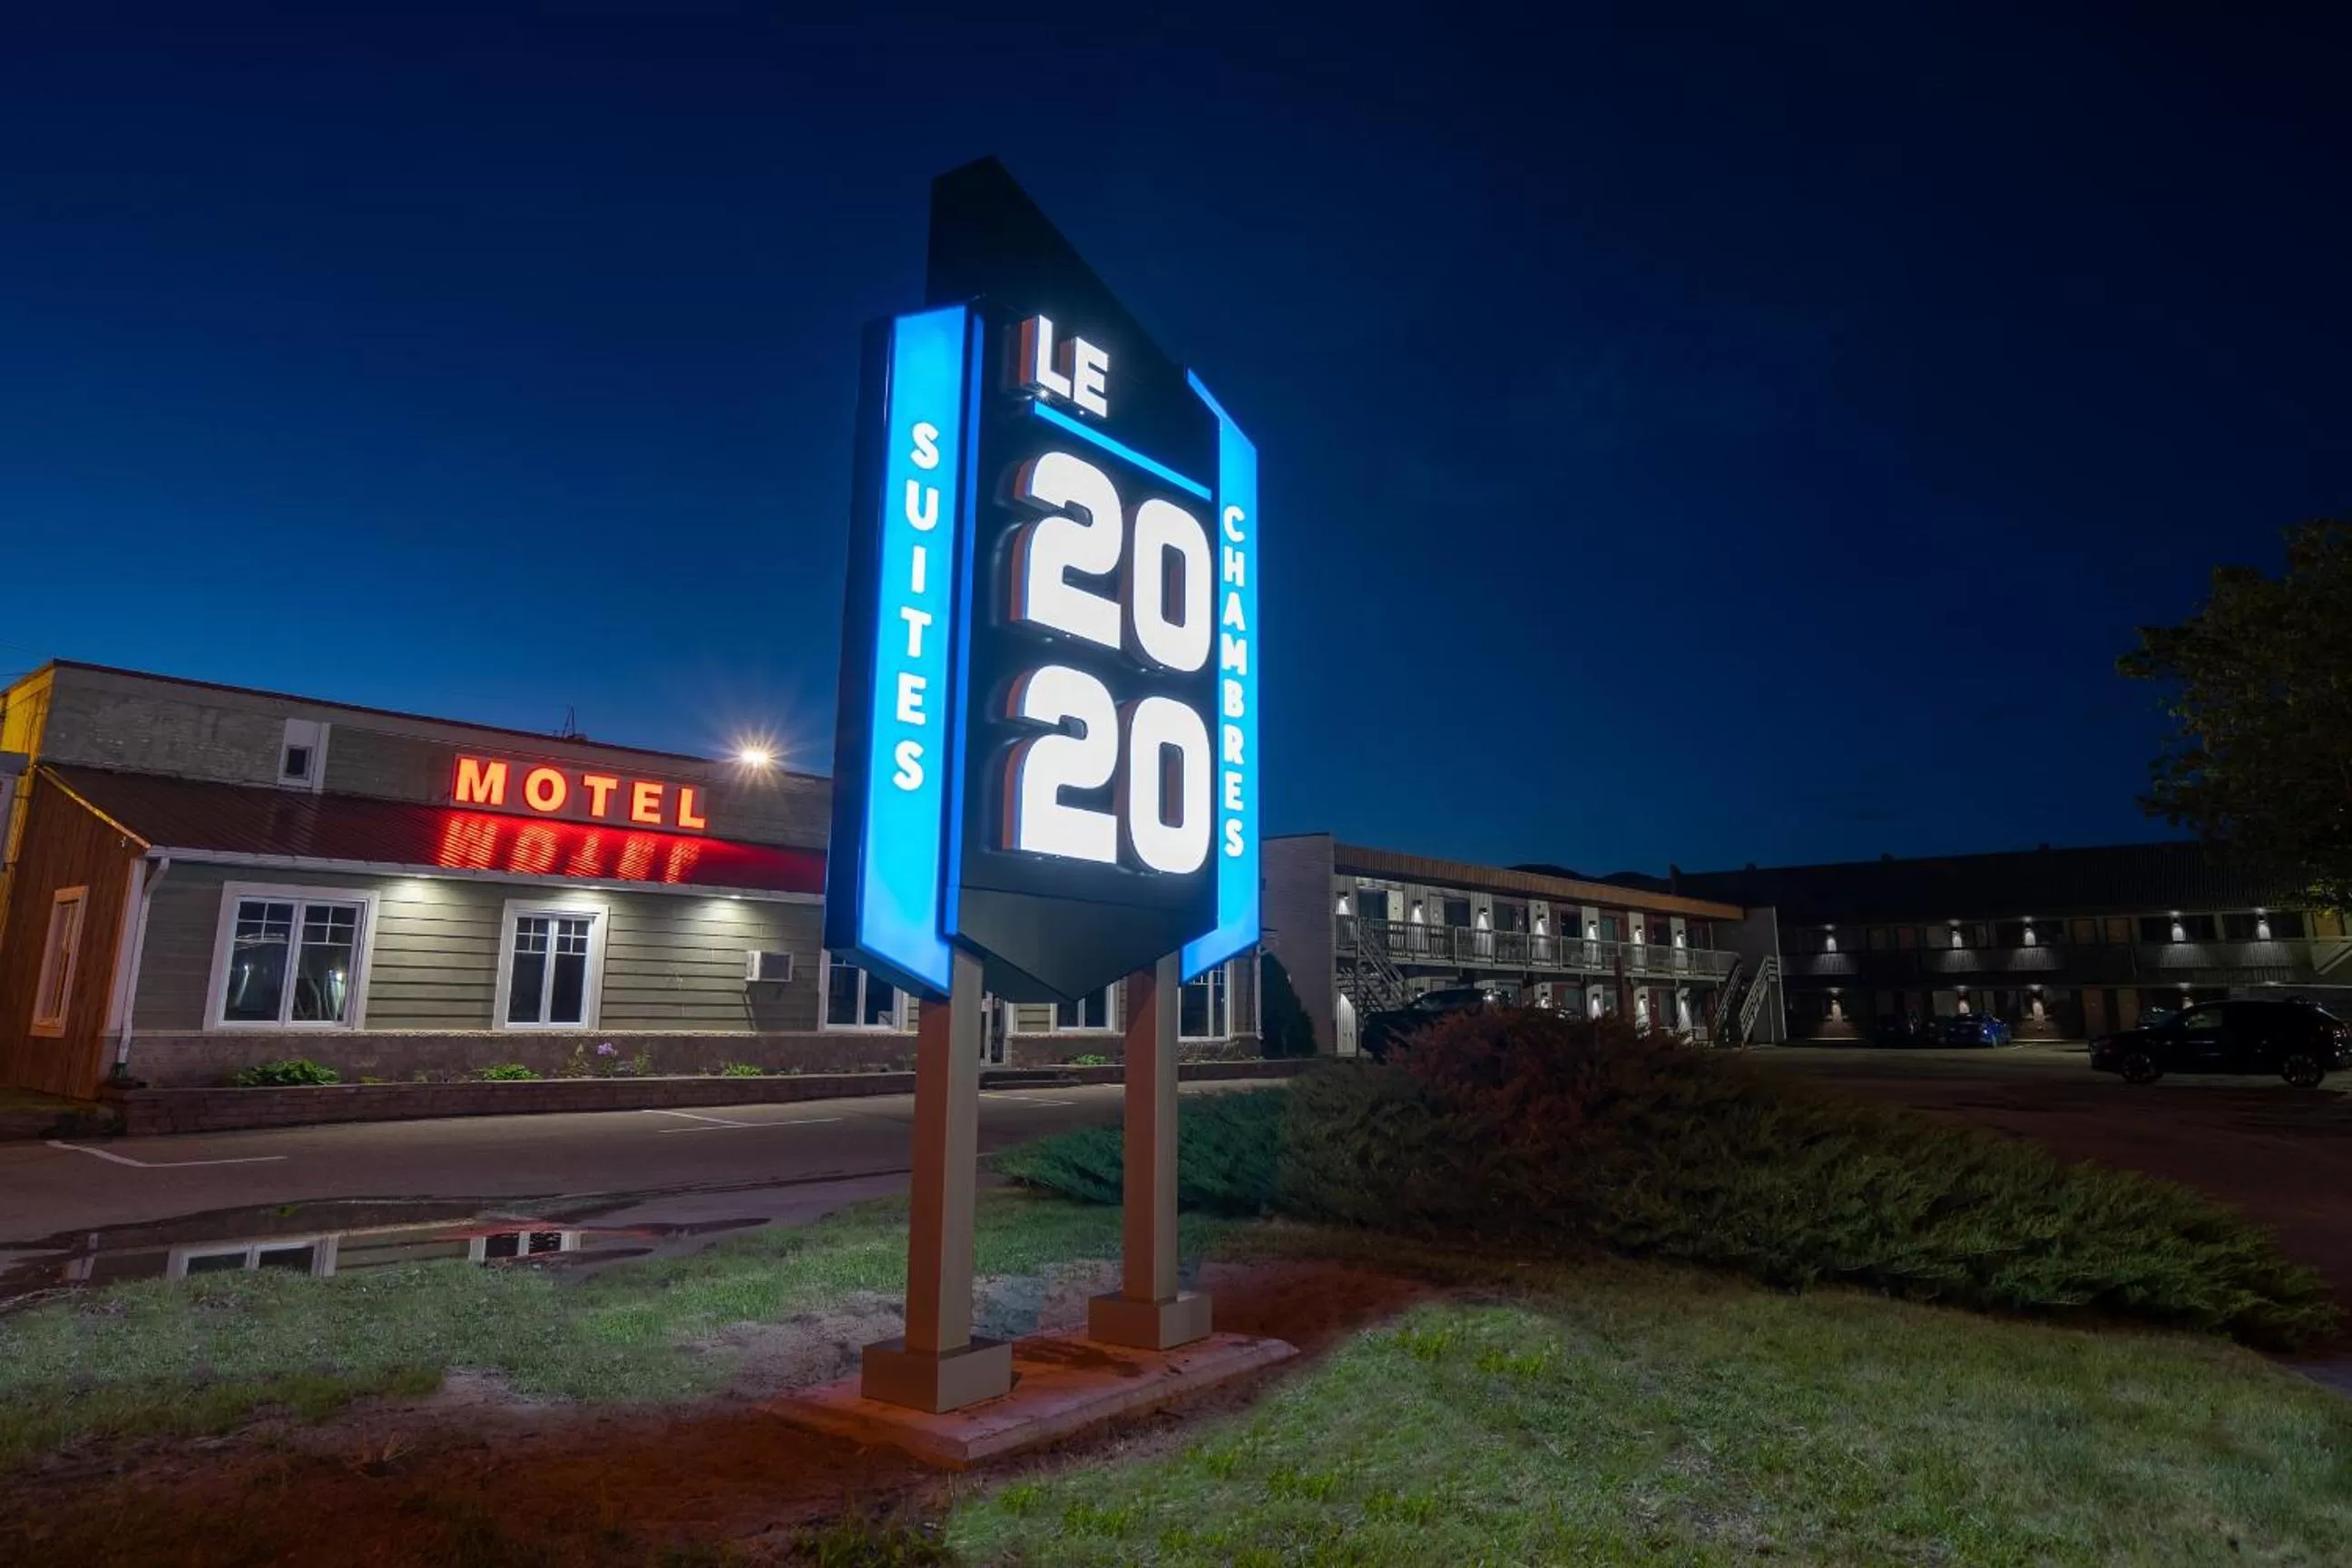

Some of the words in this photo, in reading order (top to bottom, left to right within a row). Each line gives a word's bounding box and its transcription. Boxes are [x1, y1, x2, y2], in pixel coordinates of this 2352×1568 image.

[1034, 314, 1109, 417] LE
[892, 421, 939, 790] SUITES
[1024, 451, 1212, 673] 20
[1018, 664, 1211, 874] 20
[1220, 505, 1248, 858] CHAMBRES
[455, 757, 706, 829] MOTEL
